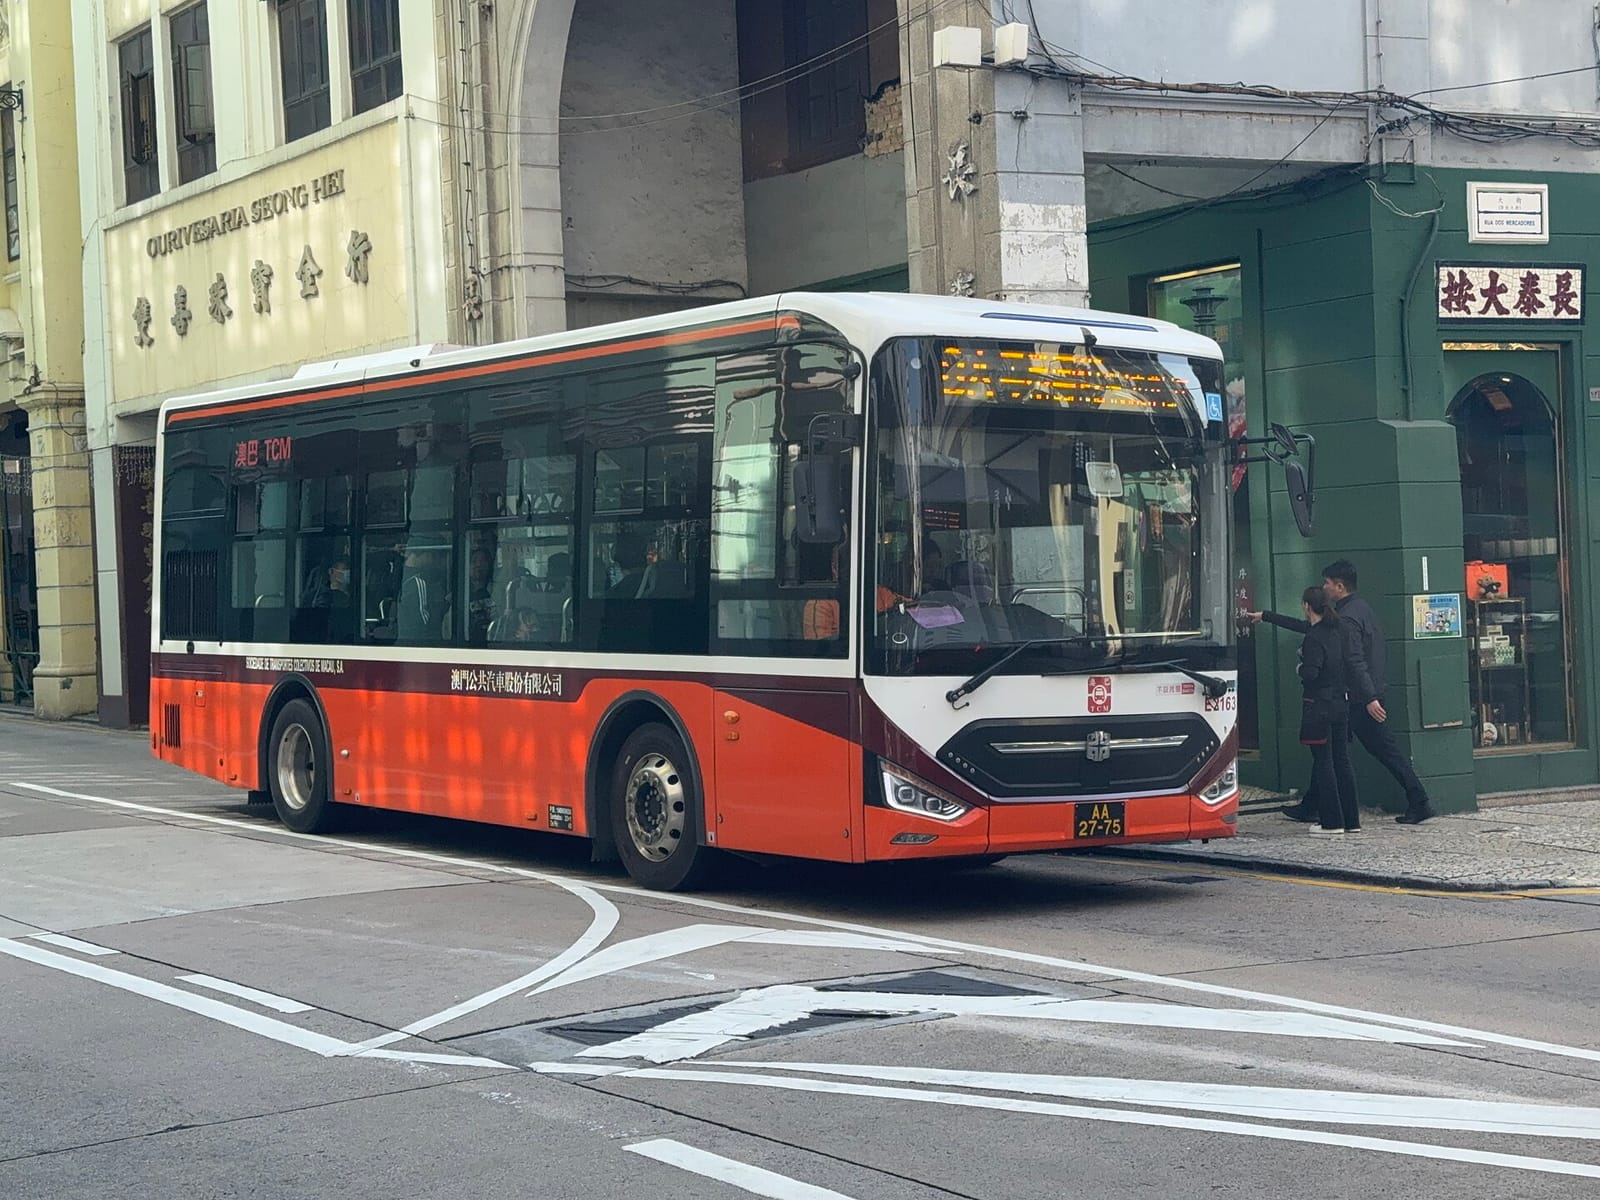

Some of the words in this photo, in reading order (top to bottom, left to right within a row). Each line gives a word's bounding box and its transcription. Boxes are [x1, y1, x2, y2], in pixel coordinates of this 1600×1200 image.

[146, 207, 249, 258] OURIVESARIA
[251, 184, 309, 224] SEONG
[311, 169, 346, 204] HEI
[264, 436, 291, 462] TCM
[451, 668, 562, 696] 澳門公共汽車股份有限公司
[1090, 705, 1109, 713] TCM
[1091, 804, 1110, 820] AA
[1079, 819, 1121, 837] 27-75
